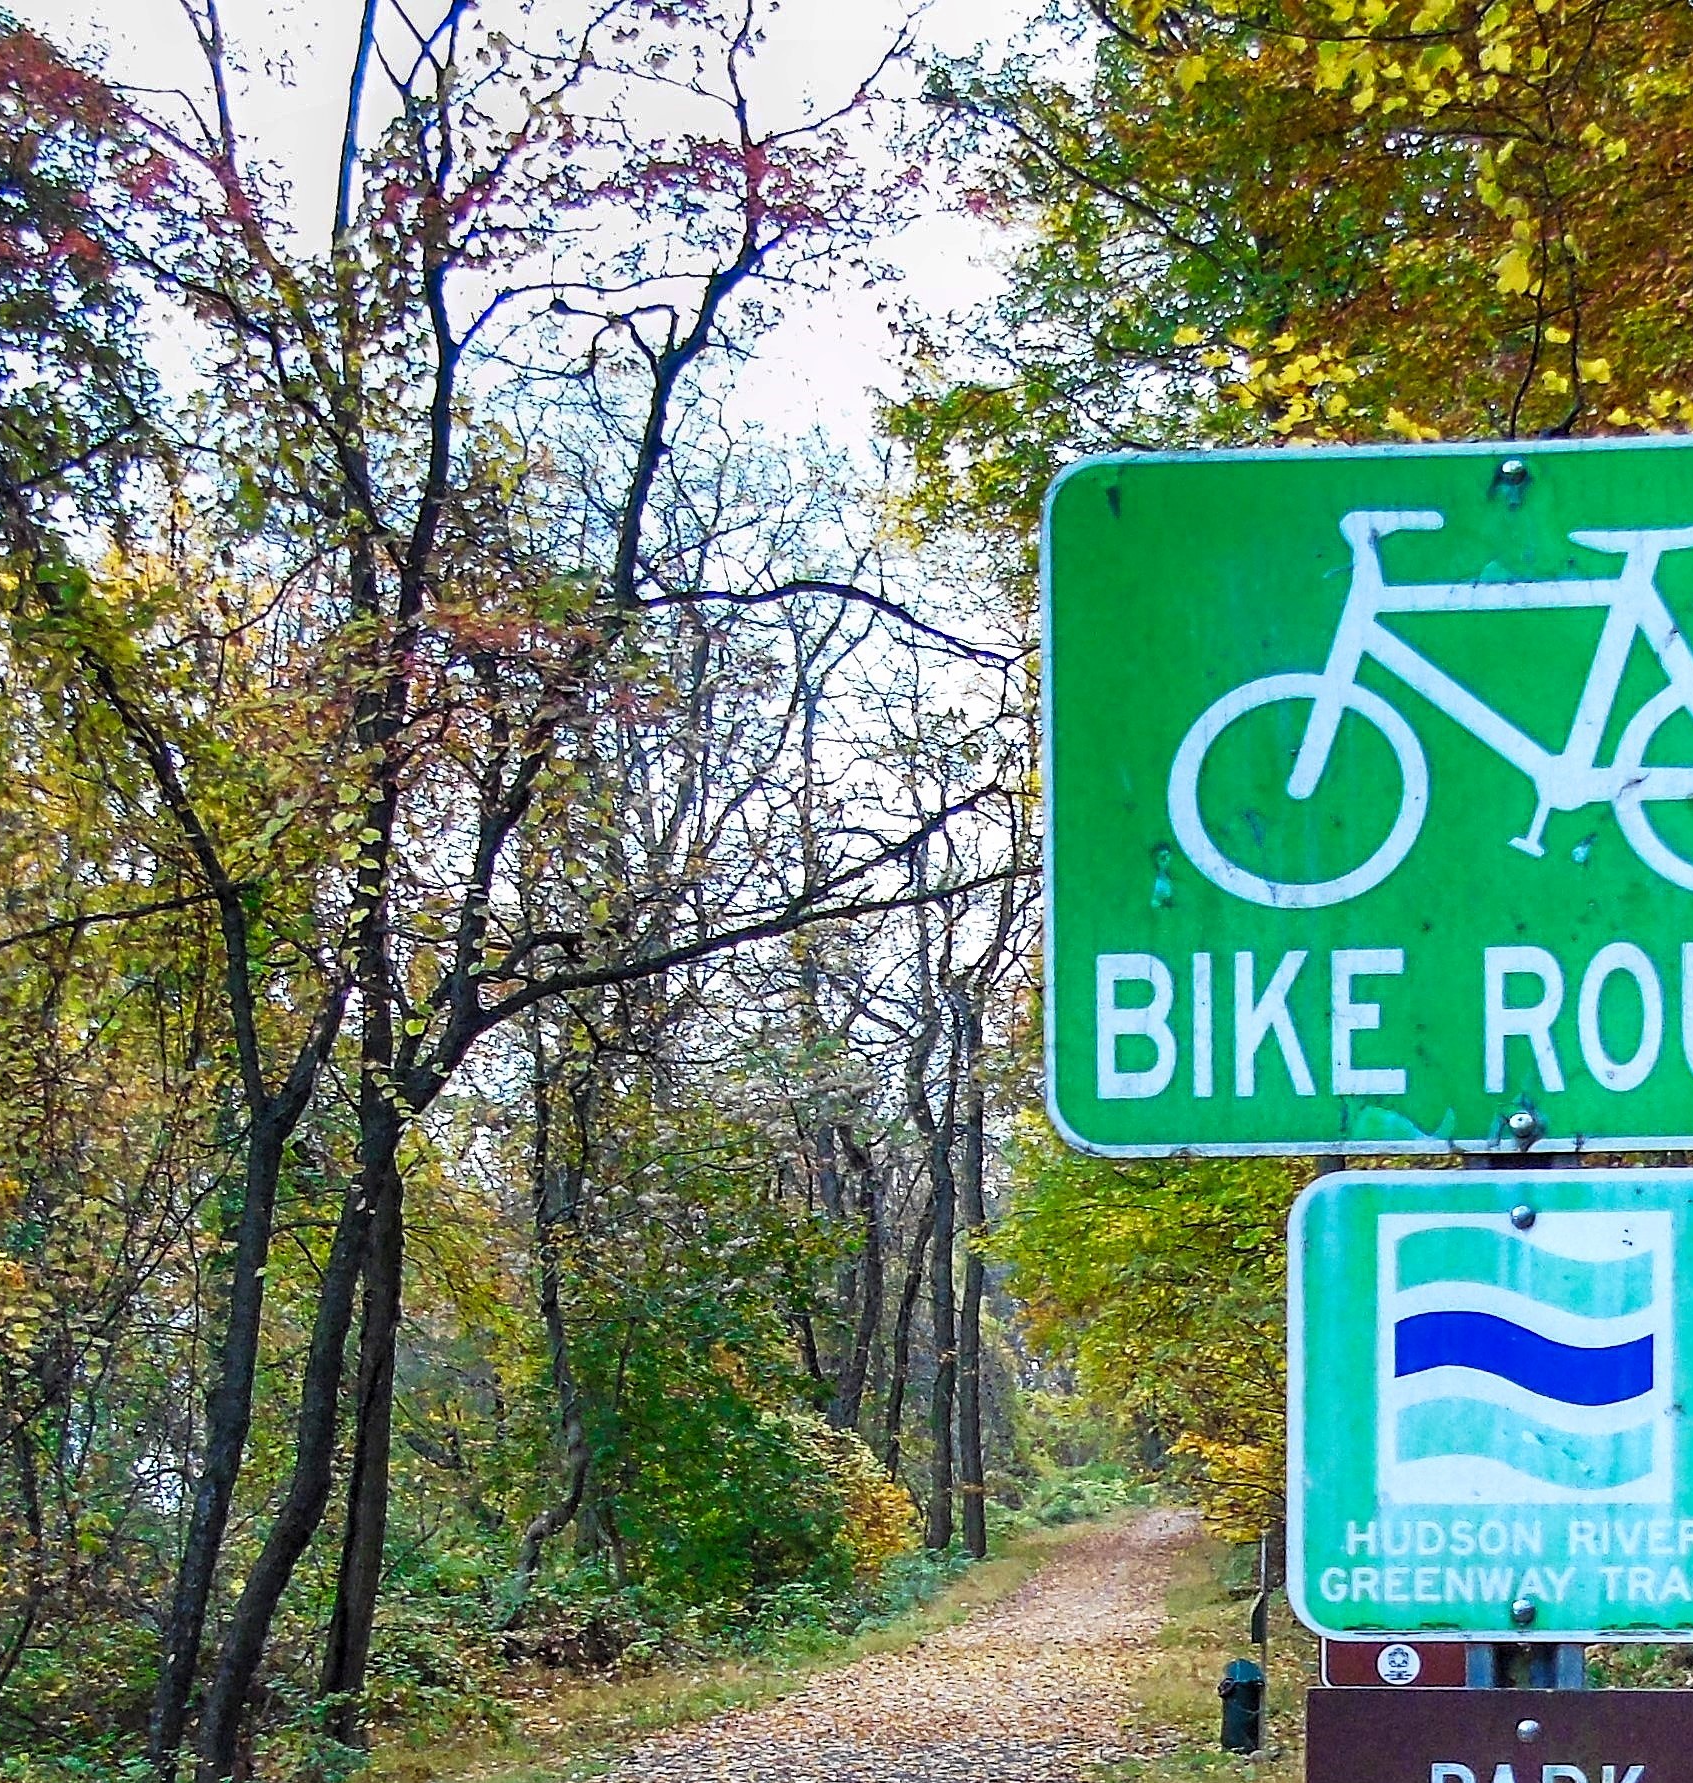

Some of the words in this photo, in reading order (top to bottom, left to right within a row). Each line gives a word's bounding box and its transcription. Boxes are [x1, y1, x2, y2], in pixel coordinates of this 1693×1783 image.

[1095, 948, 1408, 1100] BIKE
[1345, 1519, 1542, 1557] HUDSON
[1318, 1565, 1577, 1604] GREENWAY
